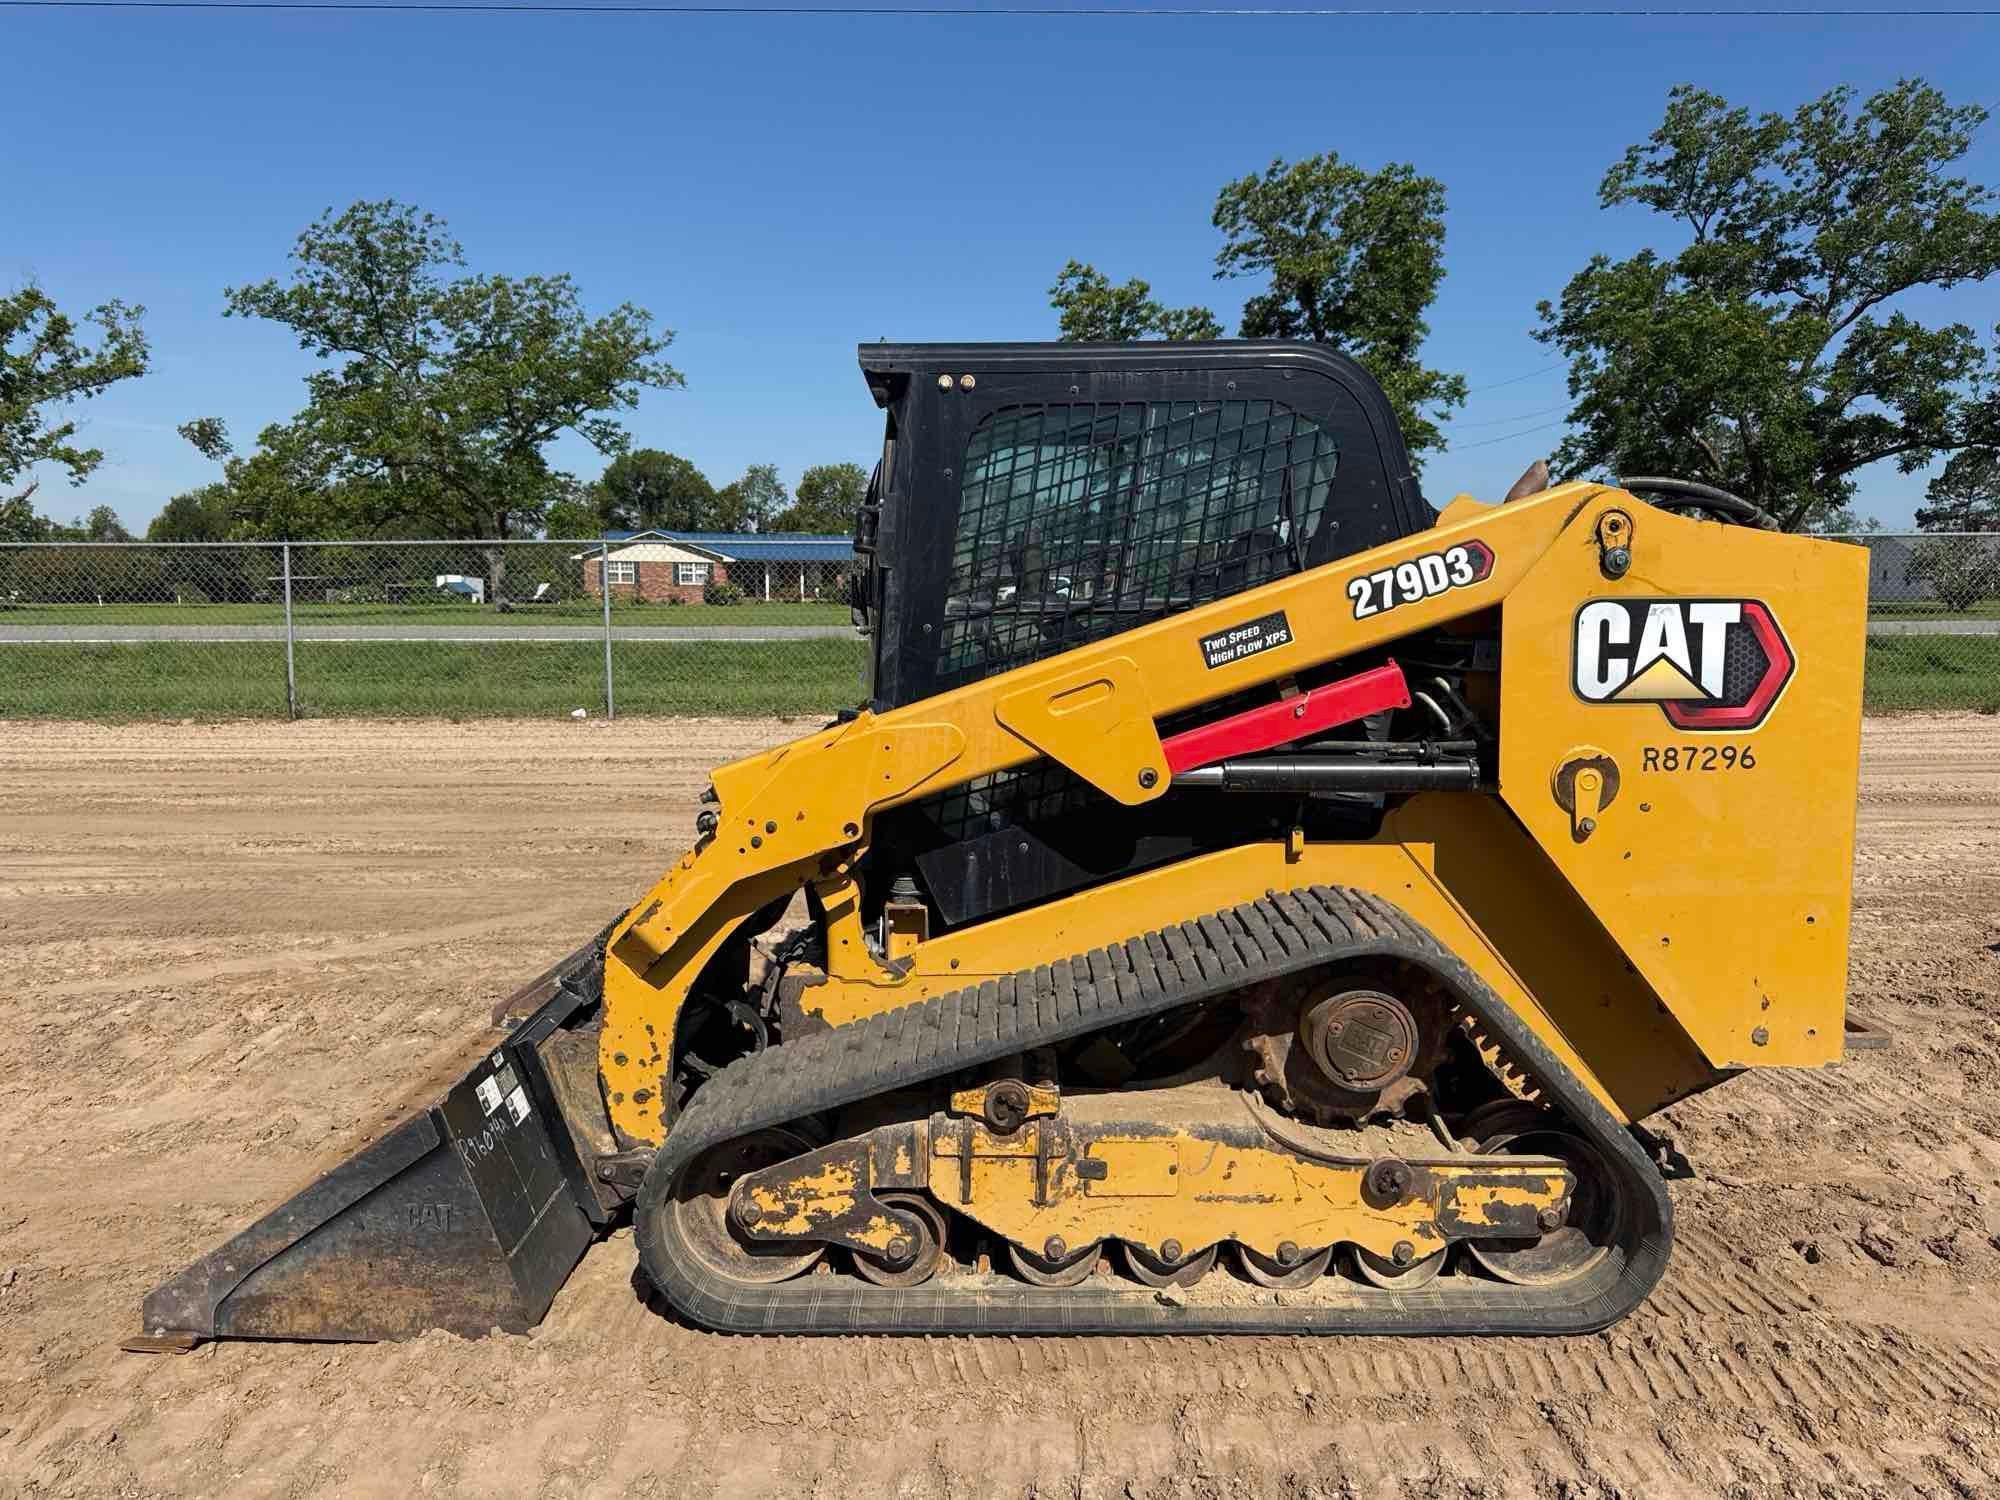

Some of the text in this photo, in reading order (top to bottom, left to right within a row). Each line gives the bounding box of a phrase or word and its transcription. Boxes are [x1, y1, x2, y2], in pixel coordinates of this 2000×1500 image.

[1348, 547, 1474, 618] 279D3
[1265, 630, 1287, 647] XPS
[1576, 602, 1741, 699] CAT
[1642, 746, 1757, 772] R87296
